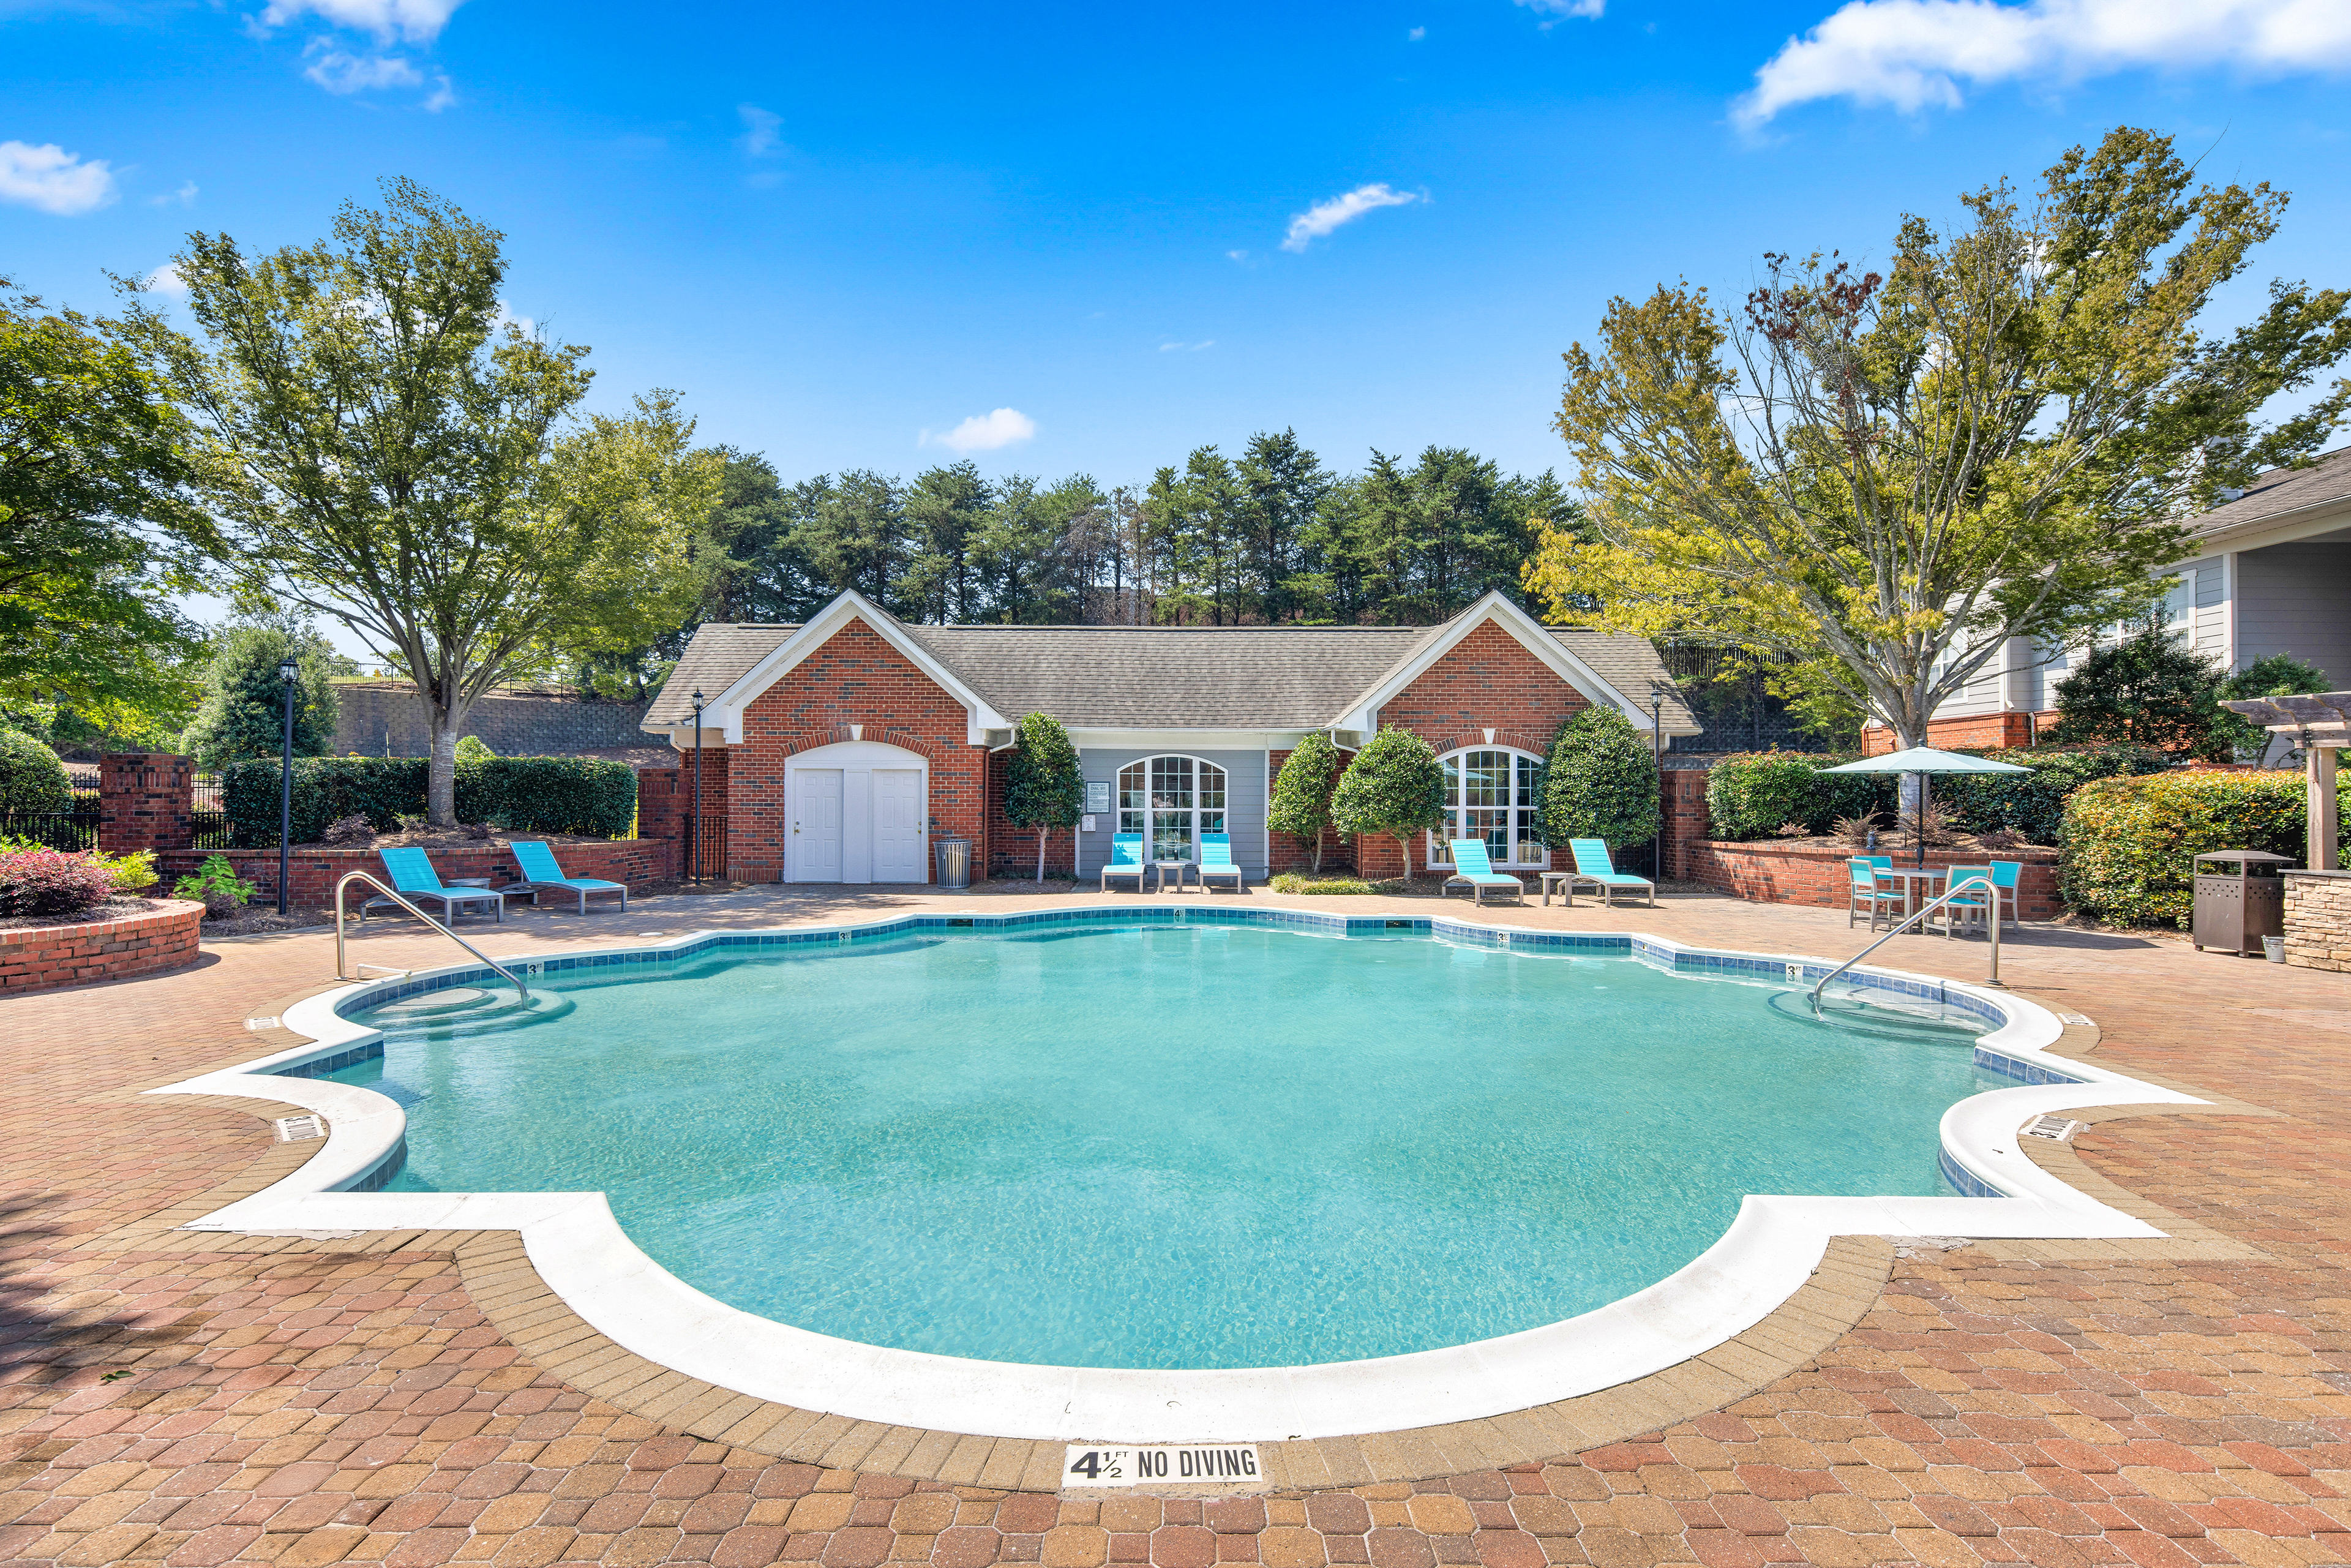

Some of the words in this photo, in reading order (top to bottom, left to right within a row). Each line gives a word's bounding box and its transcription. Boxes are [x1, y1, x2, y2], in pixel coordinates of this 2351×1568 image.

[528, 964, 537, 974] 3
[1788, 966, 1795, 975] 3
[1138, 1450, 1168, 1478] NO
[1179, 1449, 1257, 1477] DIVING
